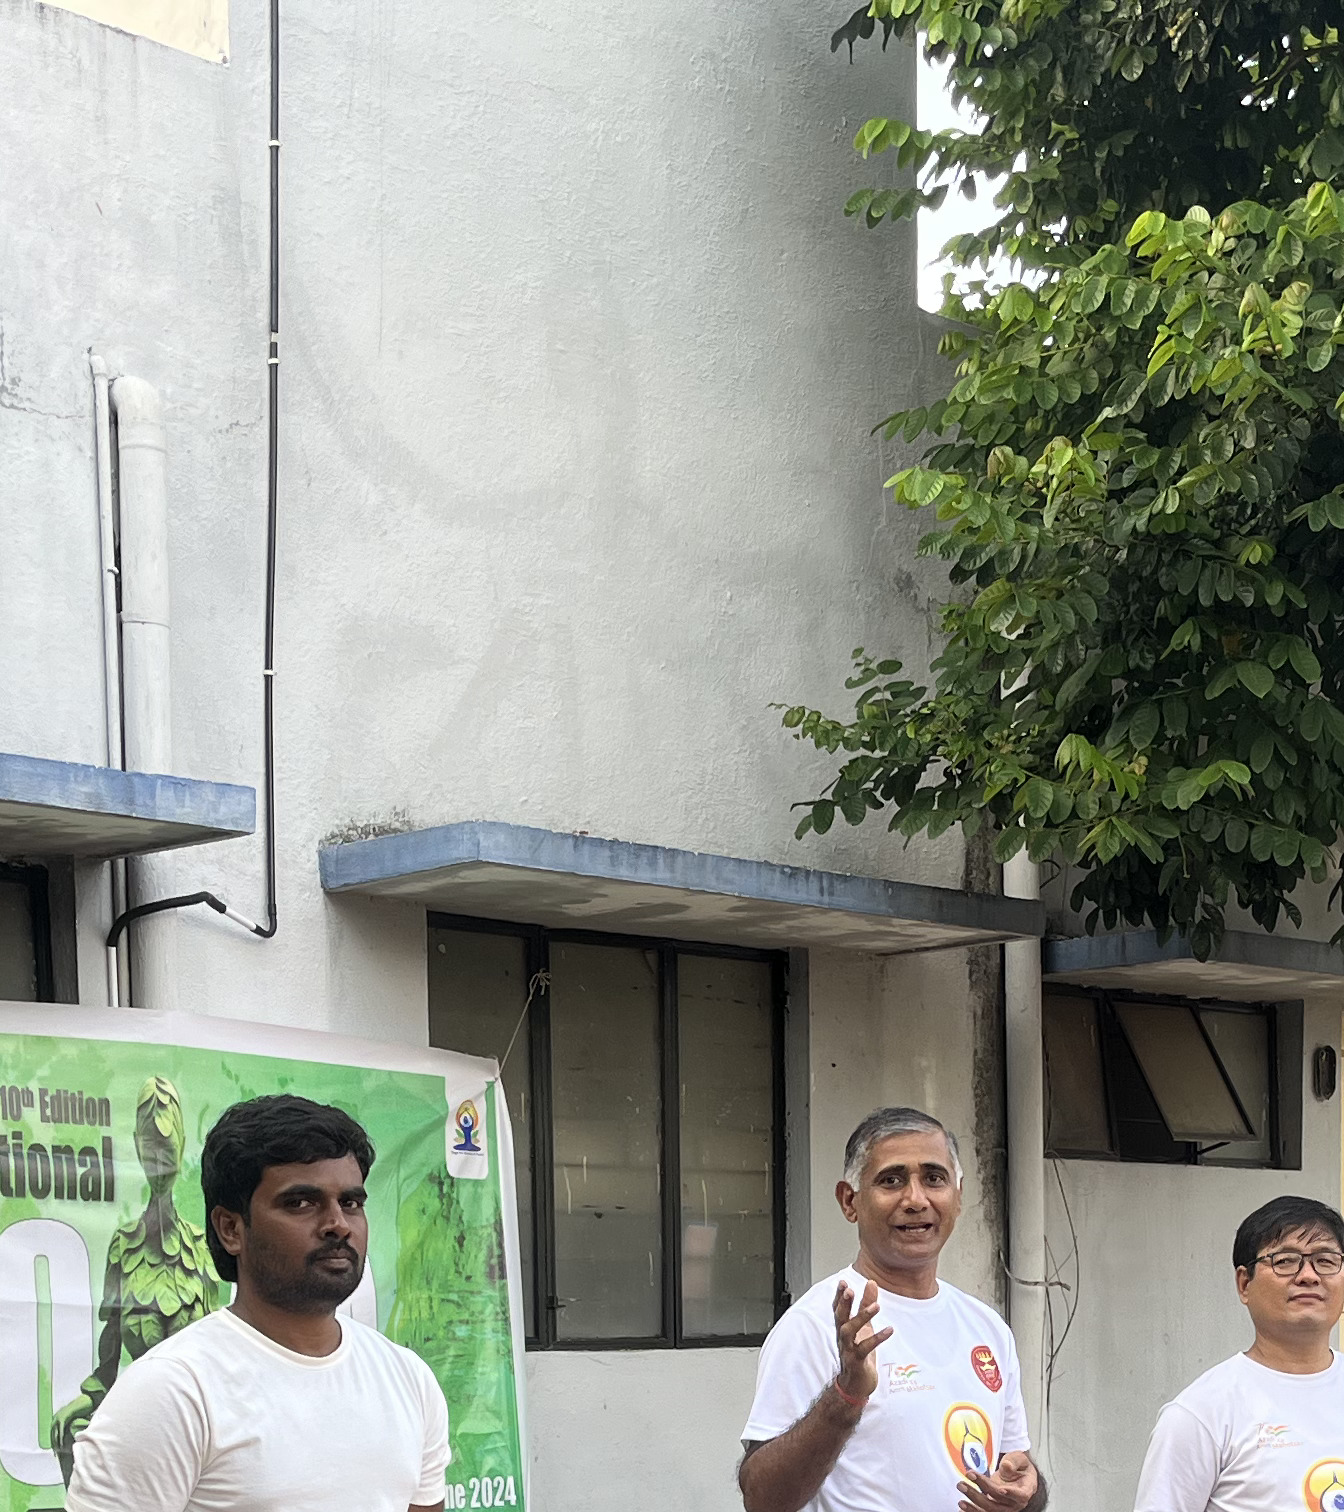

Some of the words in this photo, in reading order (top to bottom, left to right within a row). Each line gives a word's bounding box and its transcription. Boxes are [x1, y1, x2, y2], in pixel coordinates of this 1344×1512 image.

[38, 1087, 111, 1128] Edition
[444, 1483, 467, 1510] ne
[468, 1475, 517, 1509] 2024
